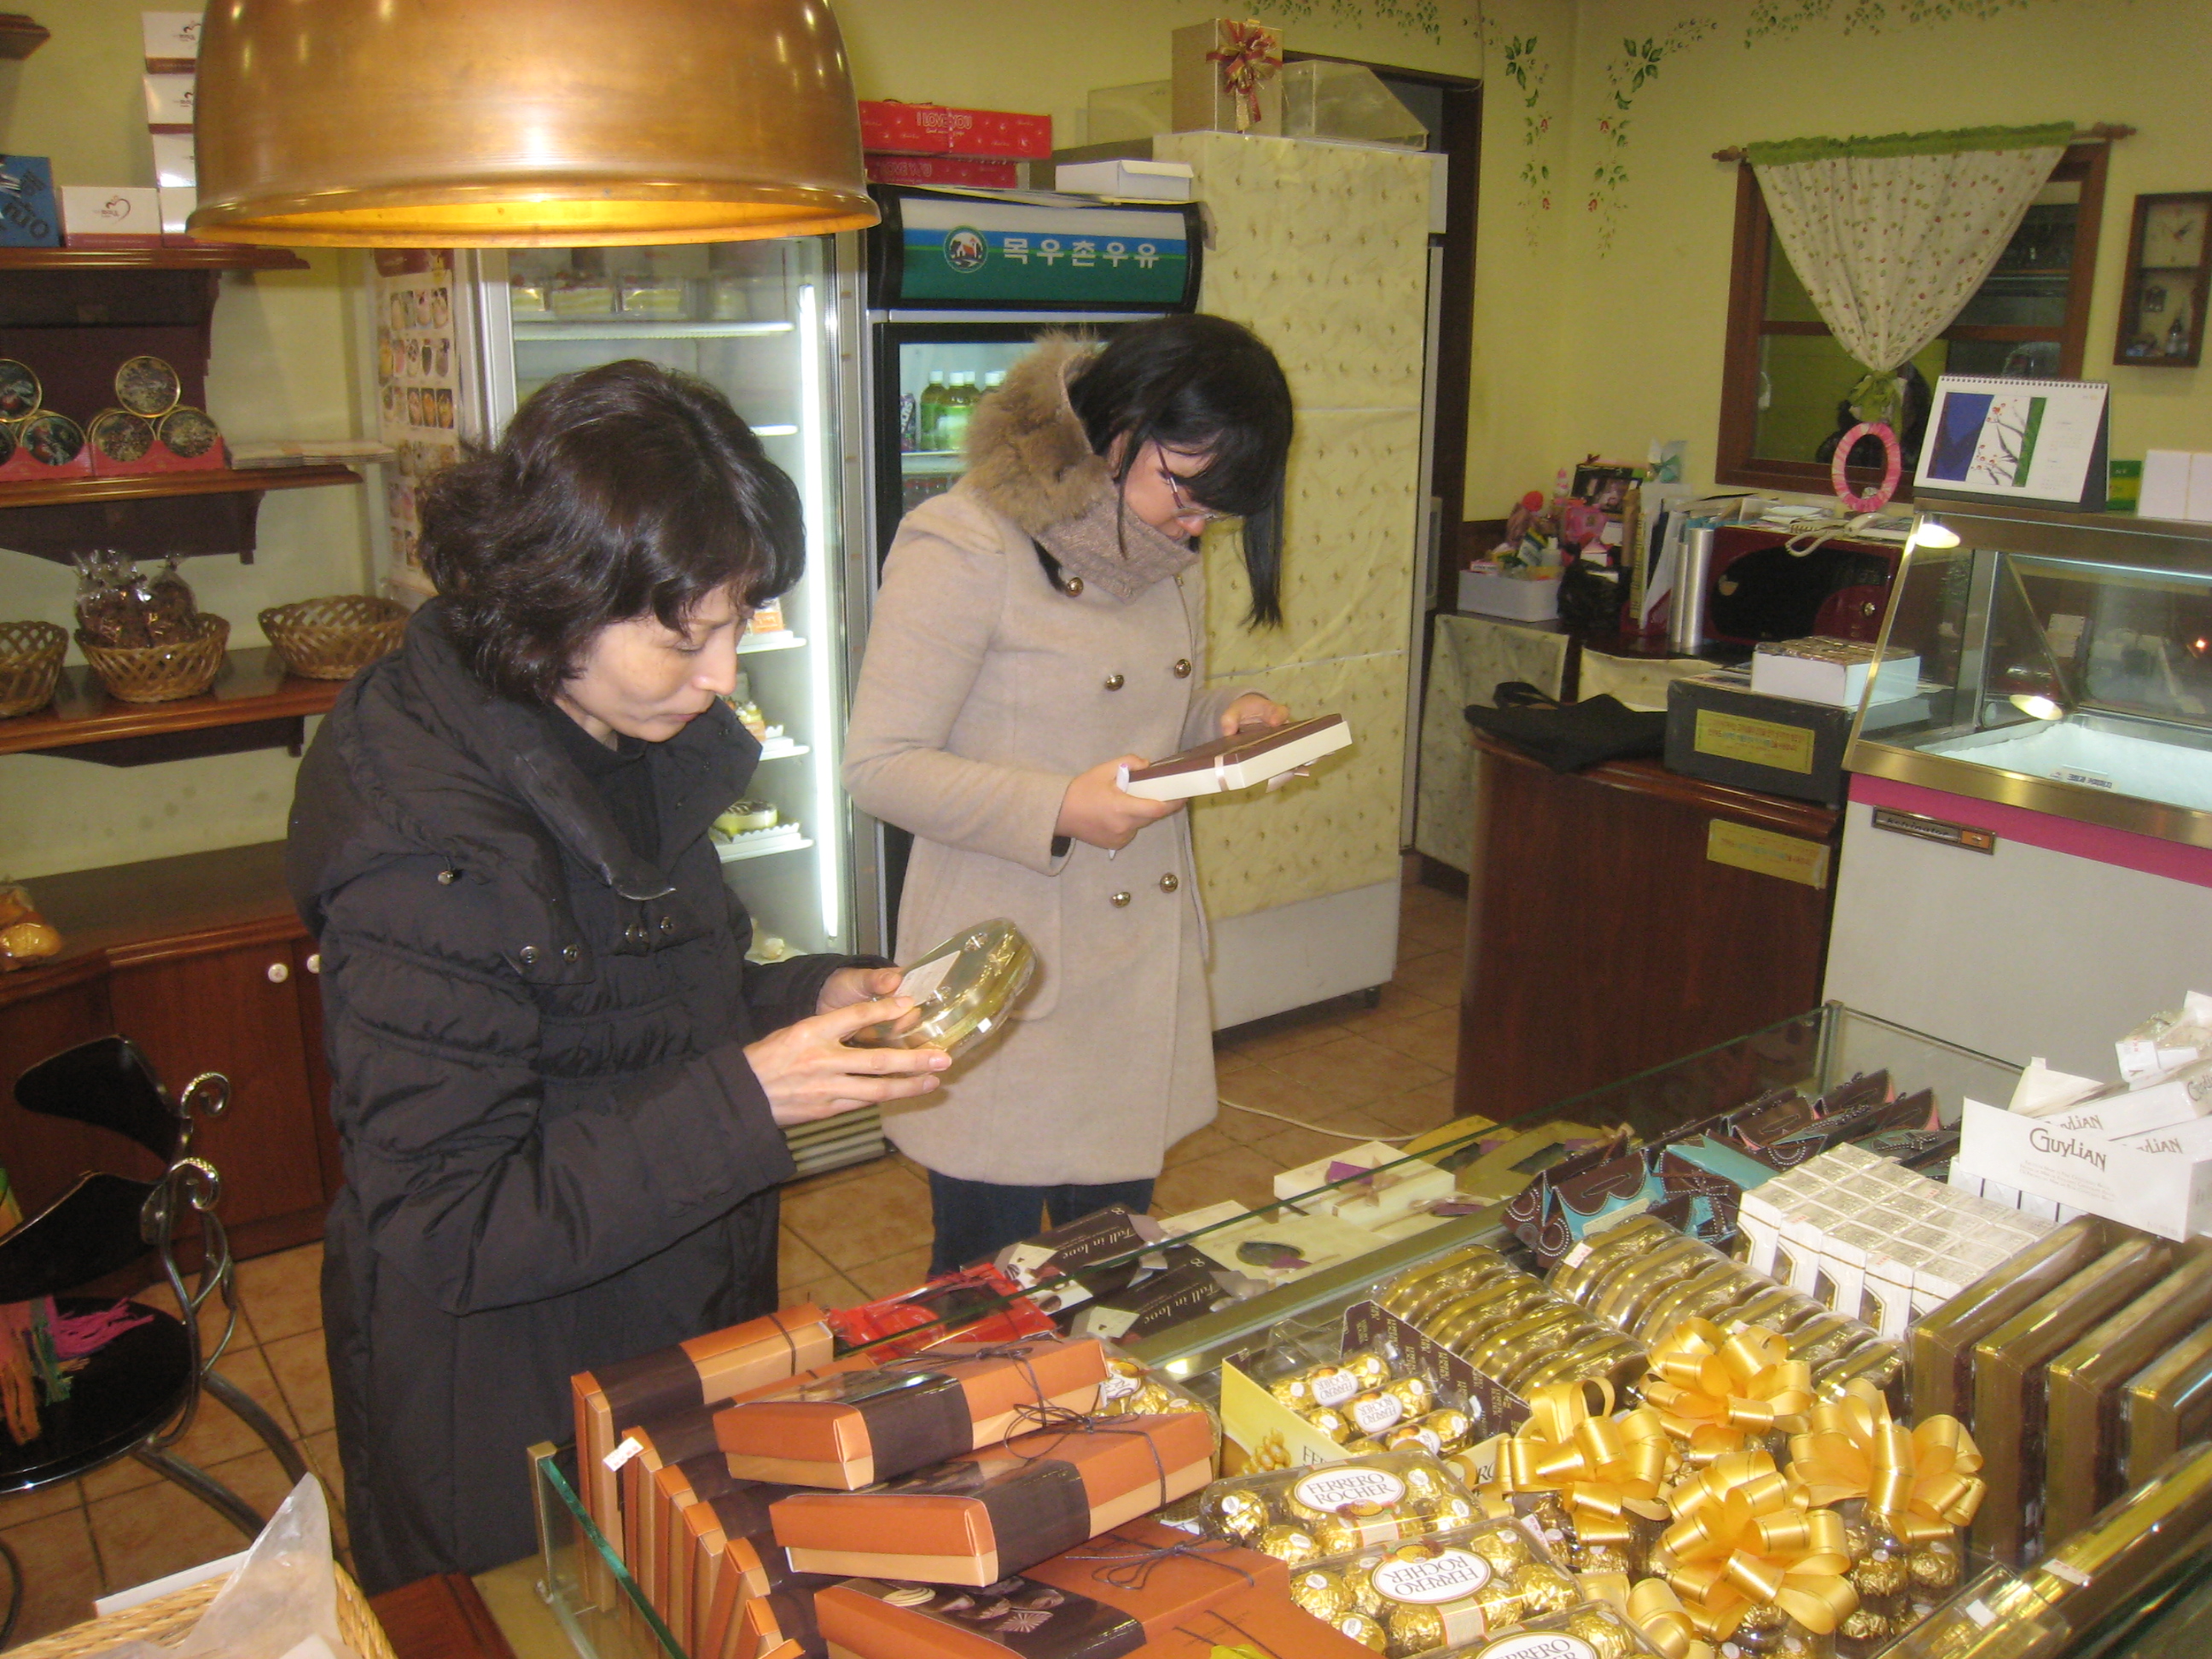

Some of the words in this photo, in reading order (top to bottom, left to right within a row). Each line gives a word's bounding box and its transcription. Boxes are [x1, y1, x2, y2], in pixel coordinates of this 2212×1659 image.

[923, 113, 948, 128] LOVE
[951, 114, 973, 130] YOU
[1004, 237, 1160, 269] 목우촌우유
[1062, 1243, 1090, 1260] love
[1092, 1237, 1106, 1250] in
[1174, 1295, 1188, 1307] in
[1144, 1304, 1172, 1324] love
[1317, 1373, 1350, 1391] ROCHER
[1319, 1382, 1354, 1400] FERRERO
[1359, 1396, 1393, 1417] ROCHER
[1362, 1407, 1398, 1426] FERRERO
[1306, 1473, 1385, 1495] FERRERO
[1314, 1484, 1398, 1505] ROCHER
[1382, 1556, 1470, 1584] ROCHER
[1394, 1568, 1480, 1596] FERRERO
